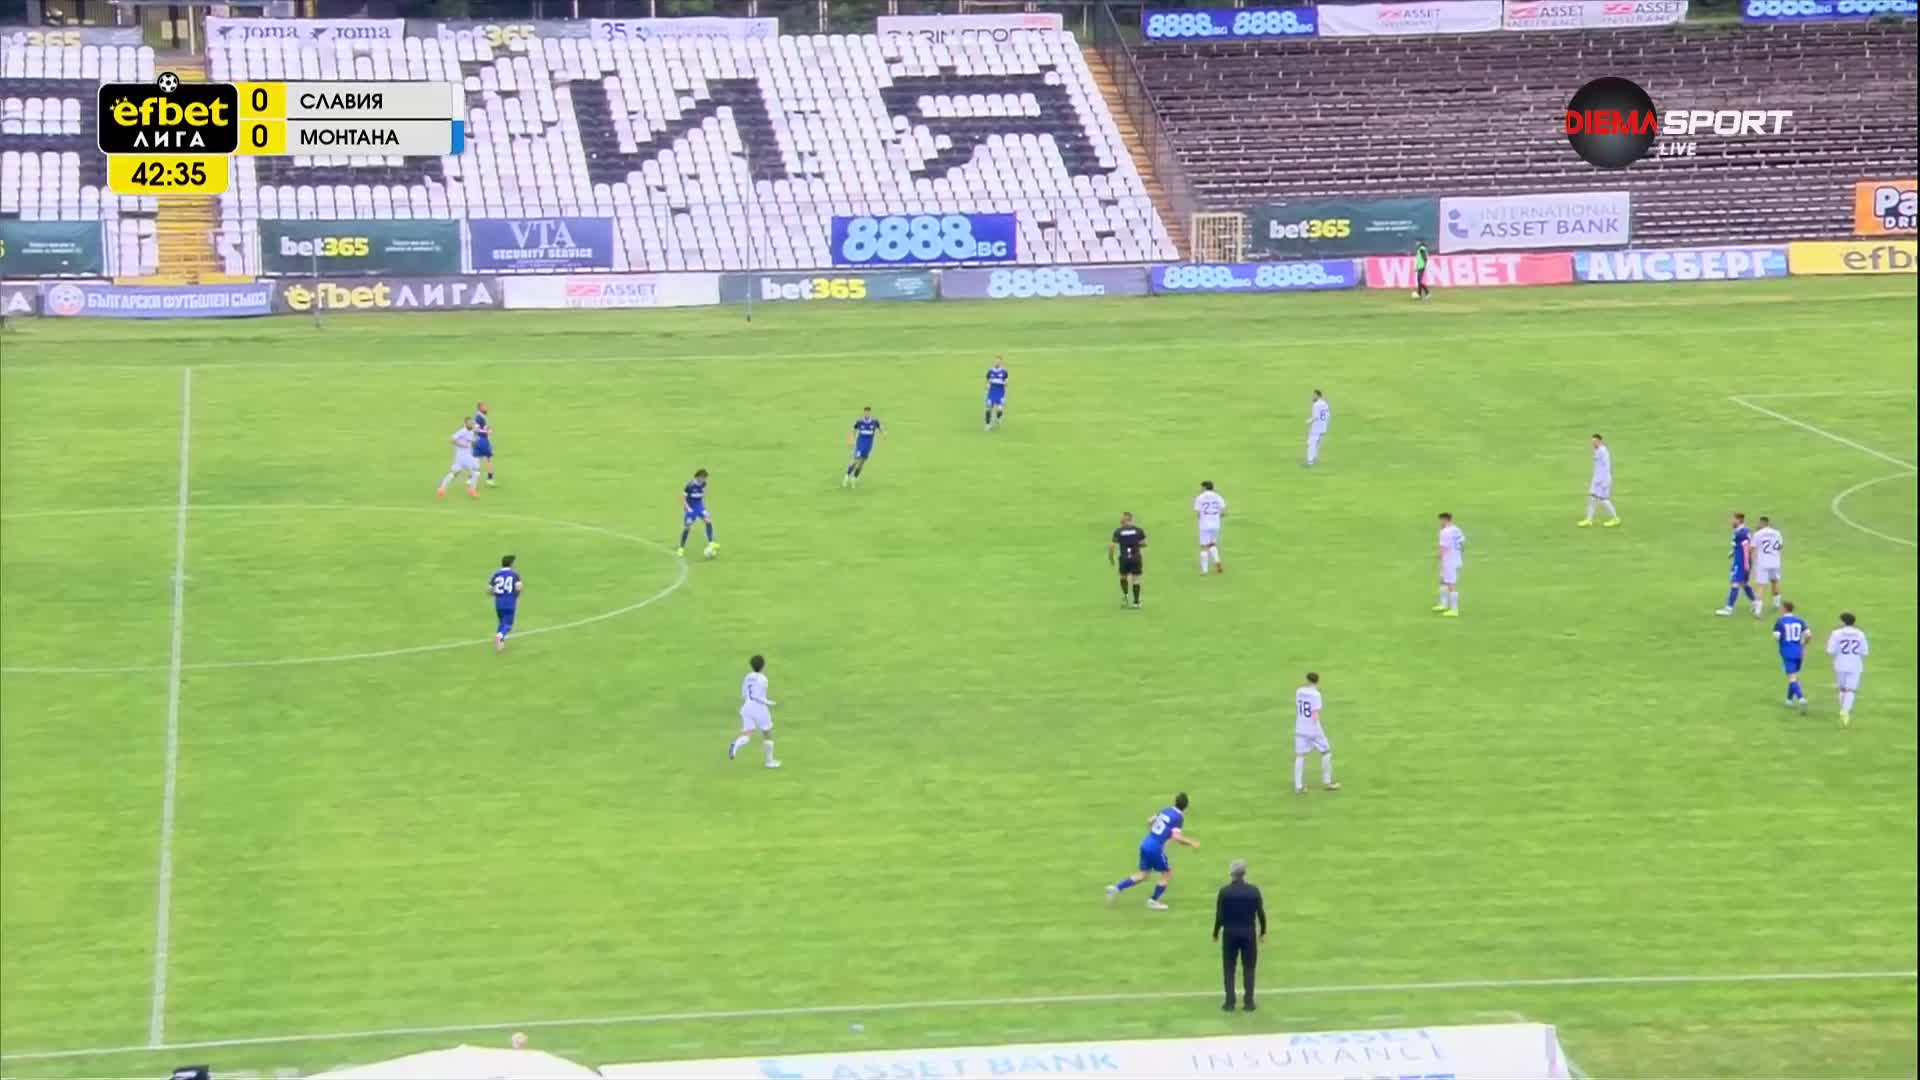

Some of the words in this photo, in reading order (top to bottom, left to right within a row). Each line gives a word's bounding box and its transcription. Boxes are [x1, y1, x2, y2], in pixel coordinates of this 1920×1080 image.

[1480, 202, 1621, 221] INTERNATIONAL
[508, 219, 577, 249] VTA
[842, 214, 1008, 262] 8888.BG
[1269, 218, 1350, 240] bet365
[1479, 219, 1549, 239] ASSET
[1556, 217, 1619, 236] BANK
[280, 236, 369, 257] bet365
[492, 248, 545, 260] SECURITY
[549, 247, 593, 259] SERVICE
[1843, 245, 1917, 270] efb
[284, 281, 391, 311] efbet
[395, 282, 494, 307] ЛИГА
[603, 283, 657, 297] ASSET
[760, 277, 867, 300] bet365
[495, 575, 513, 594] 24
[1784, 621, 1802, 642] 10
[1840, 638, 1861, 656] 22
[1298, 699, 1312, 719] 18
